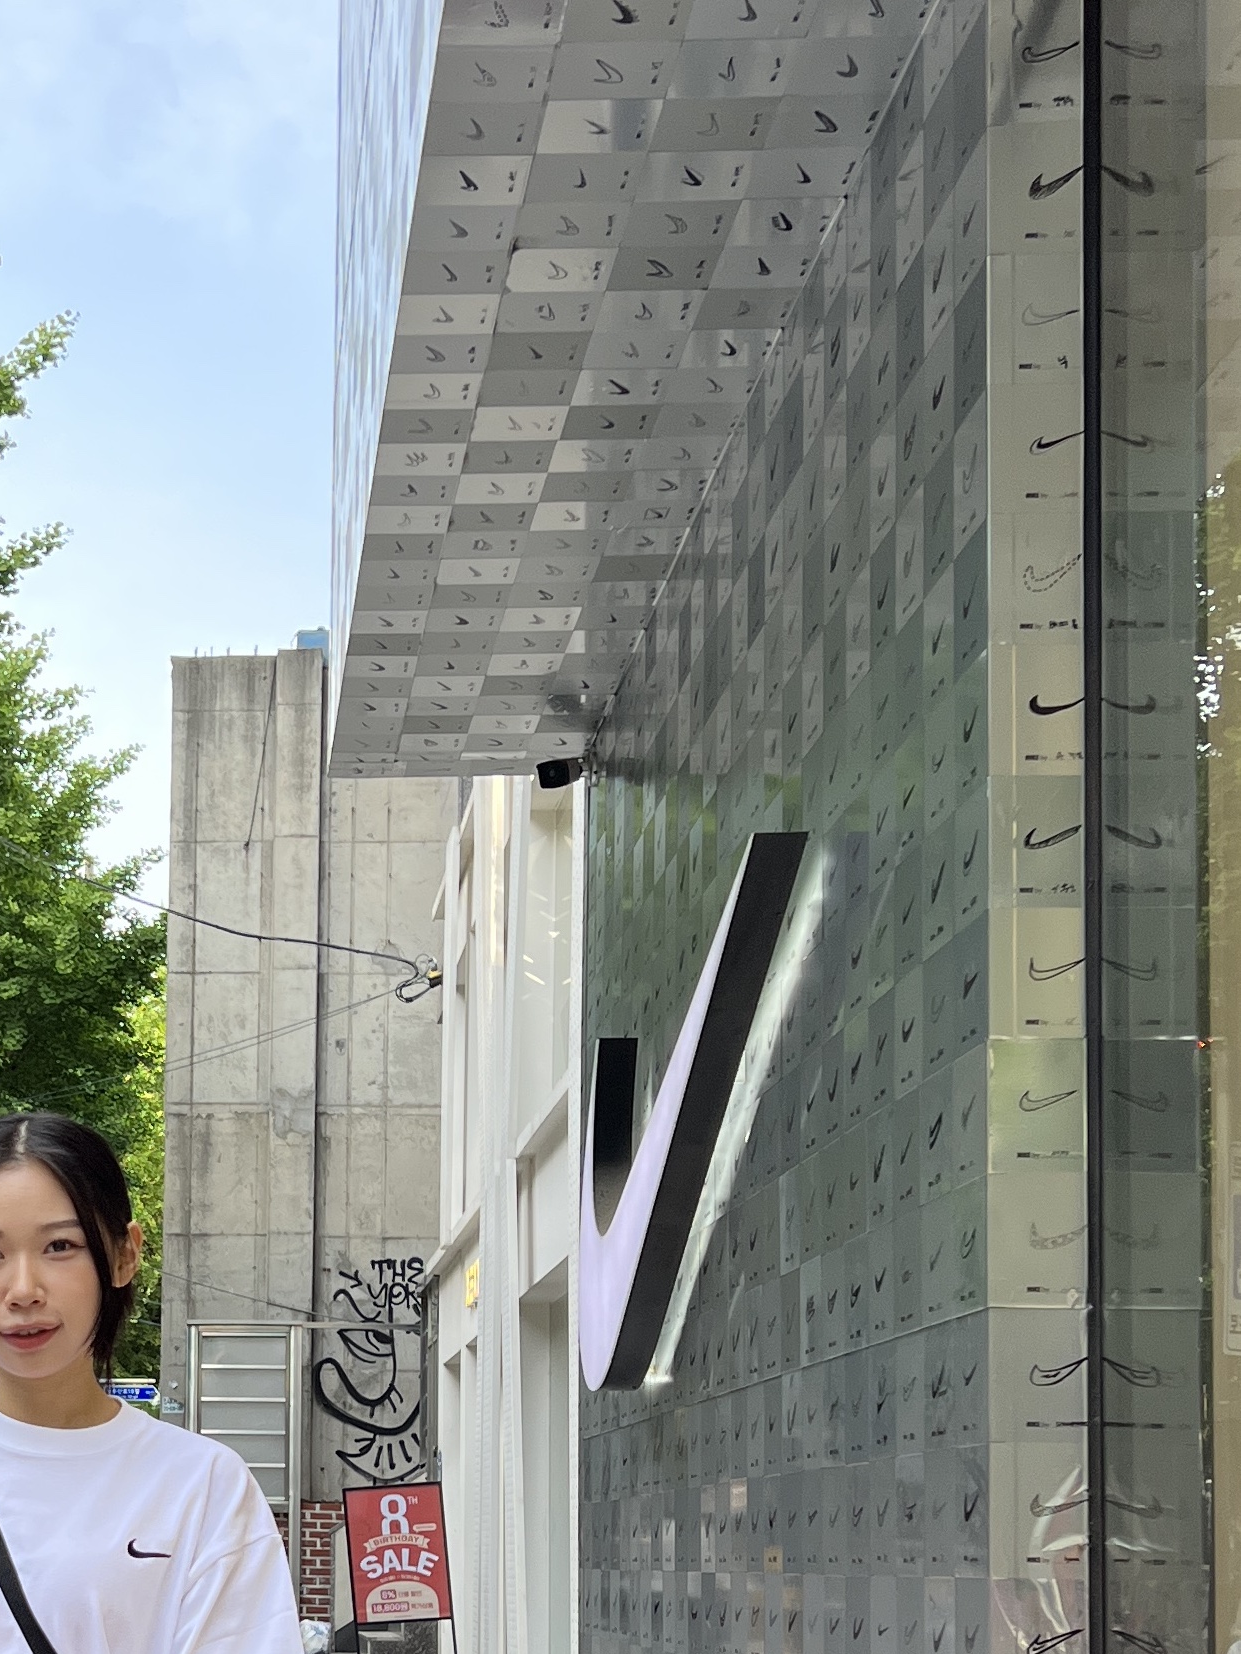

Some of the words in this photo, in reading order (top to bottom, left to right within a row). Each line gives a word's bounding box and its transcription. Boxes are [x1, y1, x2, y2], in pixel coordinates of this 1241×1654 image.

[370, 1257, 424, 1284] THE
[407, 1496, 418, 1505] TH
[360, 1548, 439, 1579] SALE
